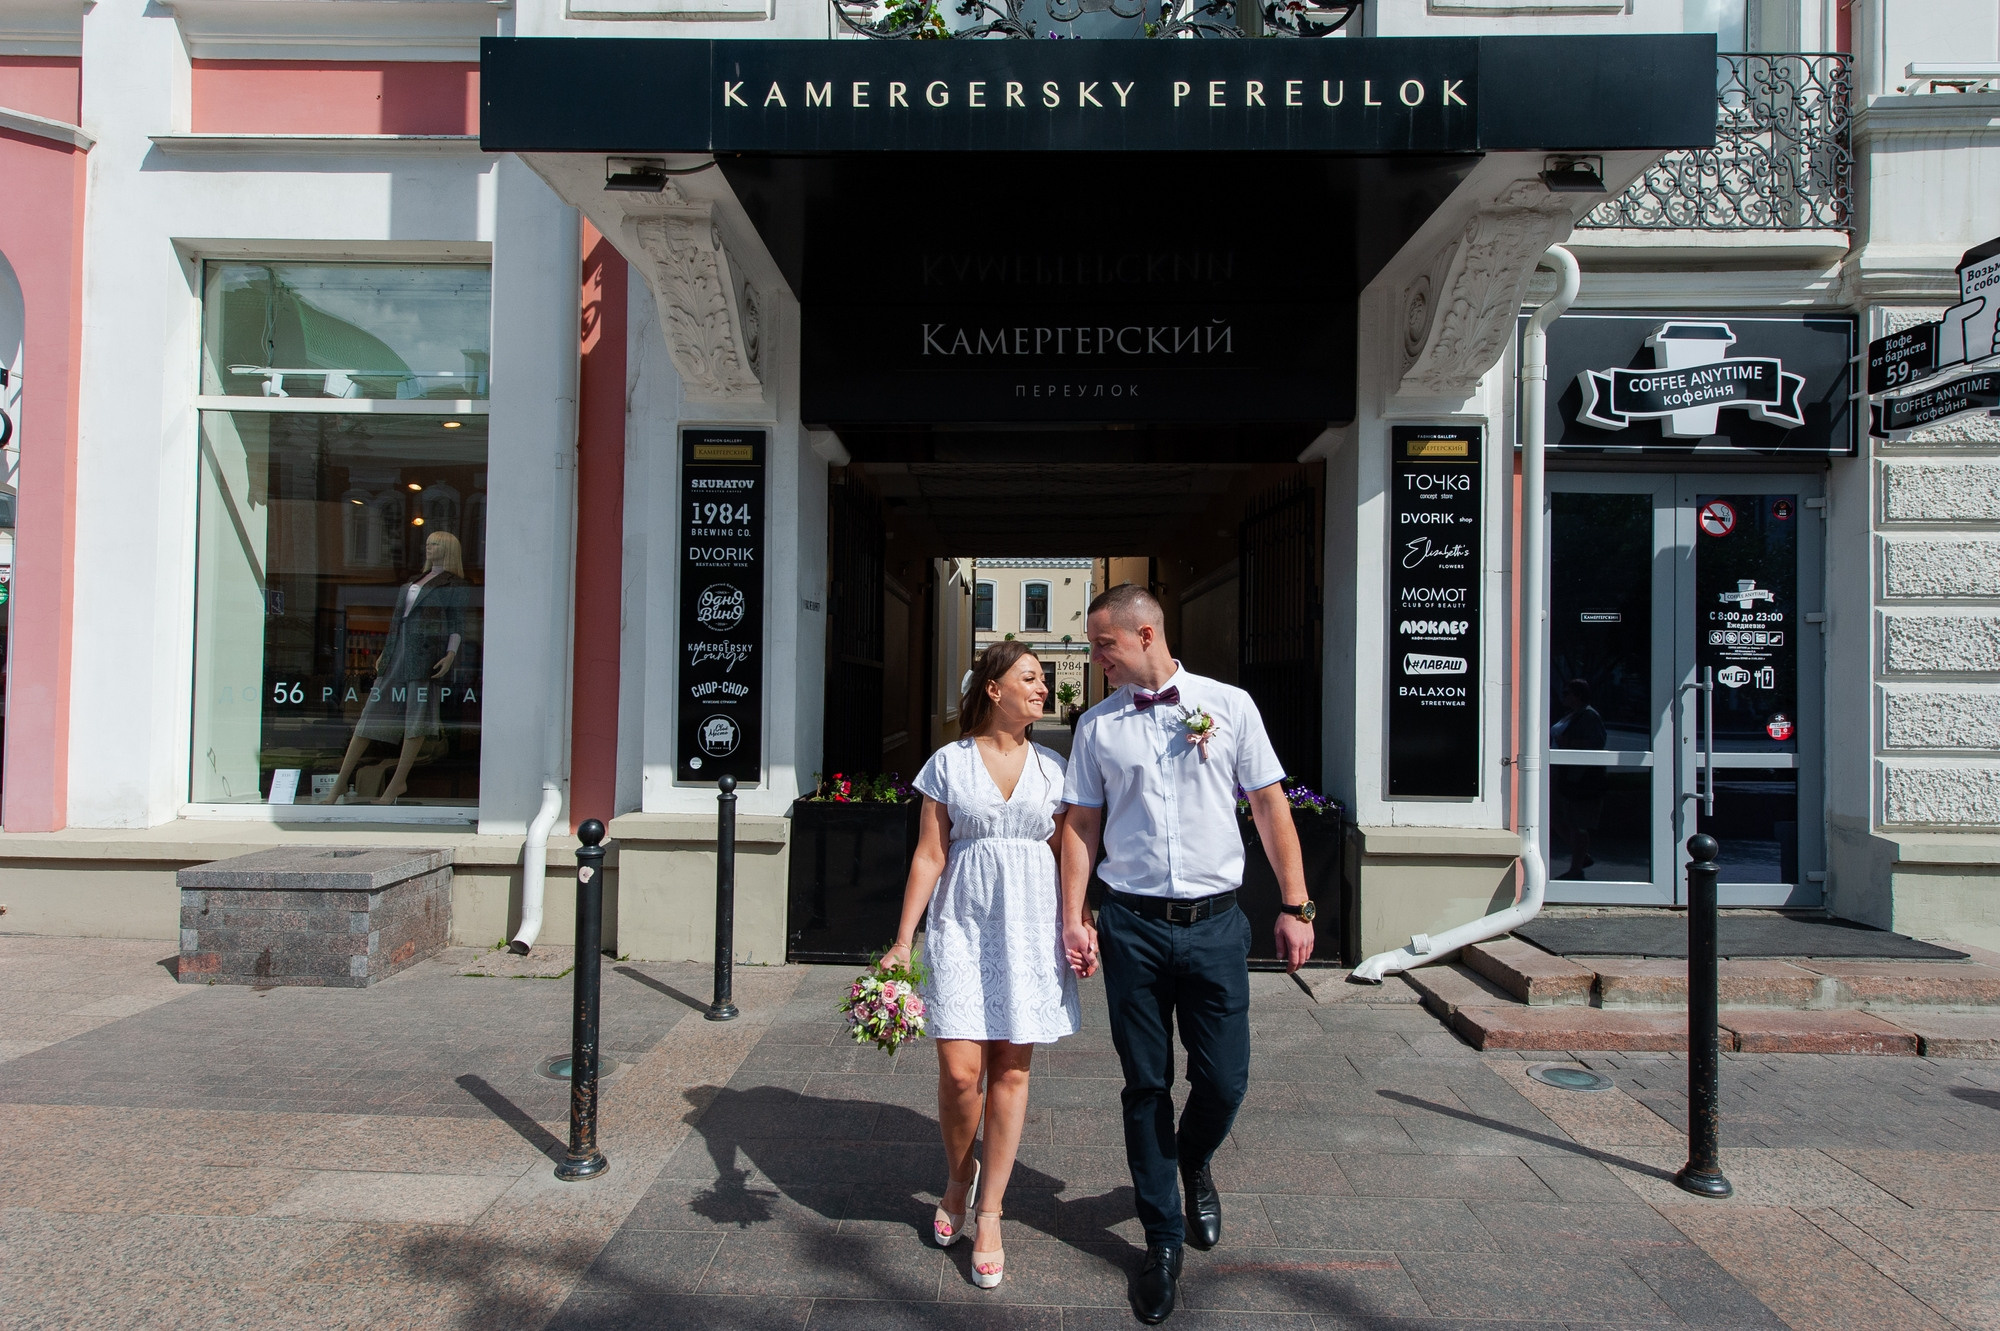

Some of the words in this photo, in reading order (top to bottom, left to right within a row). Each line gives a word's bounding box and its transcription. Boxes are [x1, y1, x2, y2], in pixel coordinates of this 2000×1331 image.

[723, 80, 1136, 108] KAMERGERSKY
[1173, 79, 1468, 107] PEREULOK
[1885, 333, 1913, 351] Кофе
[1872, 356, 1883, 367] от
[1885, 341, 1927, 363] бариста
[1629, 374, 1687, 393] COFFEE
[1691, 366, 1763, 387] ANYTIME
[1886, 361, 1909, 386] 59
[1016, 384, 1140, 397] ПЕРЕУЛОК
[1663, 384, 1735, 406] кофейня
[1894, 395, 1933, 414] COFFEE
[1936, 378, 1991, 404] ANYTIME
[1916, 398, 1968, 422] кофейня
[691, 479, 755, 489] SKURATOV
[692, 502, 752, 525] 1984
[1401, 512, 1454, 524] DVORIK
[691, 528, 734, 537] BREWING
[737, 528, 752, 537] CO.
[689, 547, 754, 560] DVORIK
[1401, 586, 1467, 601] MOMOT
[1718, 611, 1740, 621] 8:00
[1741, 613, 1754, 622] до
[1756, 612, 1783, 621] 23:00
[688, 641, 753, 653] KAMERGERSKY
[1057, 661, 1082, 670] 1984
[1413, 660, 1462, 671] #ЛАВАШ
[273, 682, 304, 704] 56
[322, 686, 477, 703] РАЗМЕРА
[691, 681, 749, 697] CHOP-CHOP
[1399, 686, 1466, 697] BALAXON
